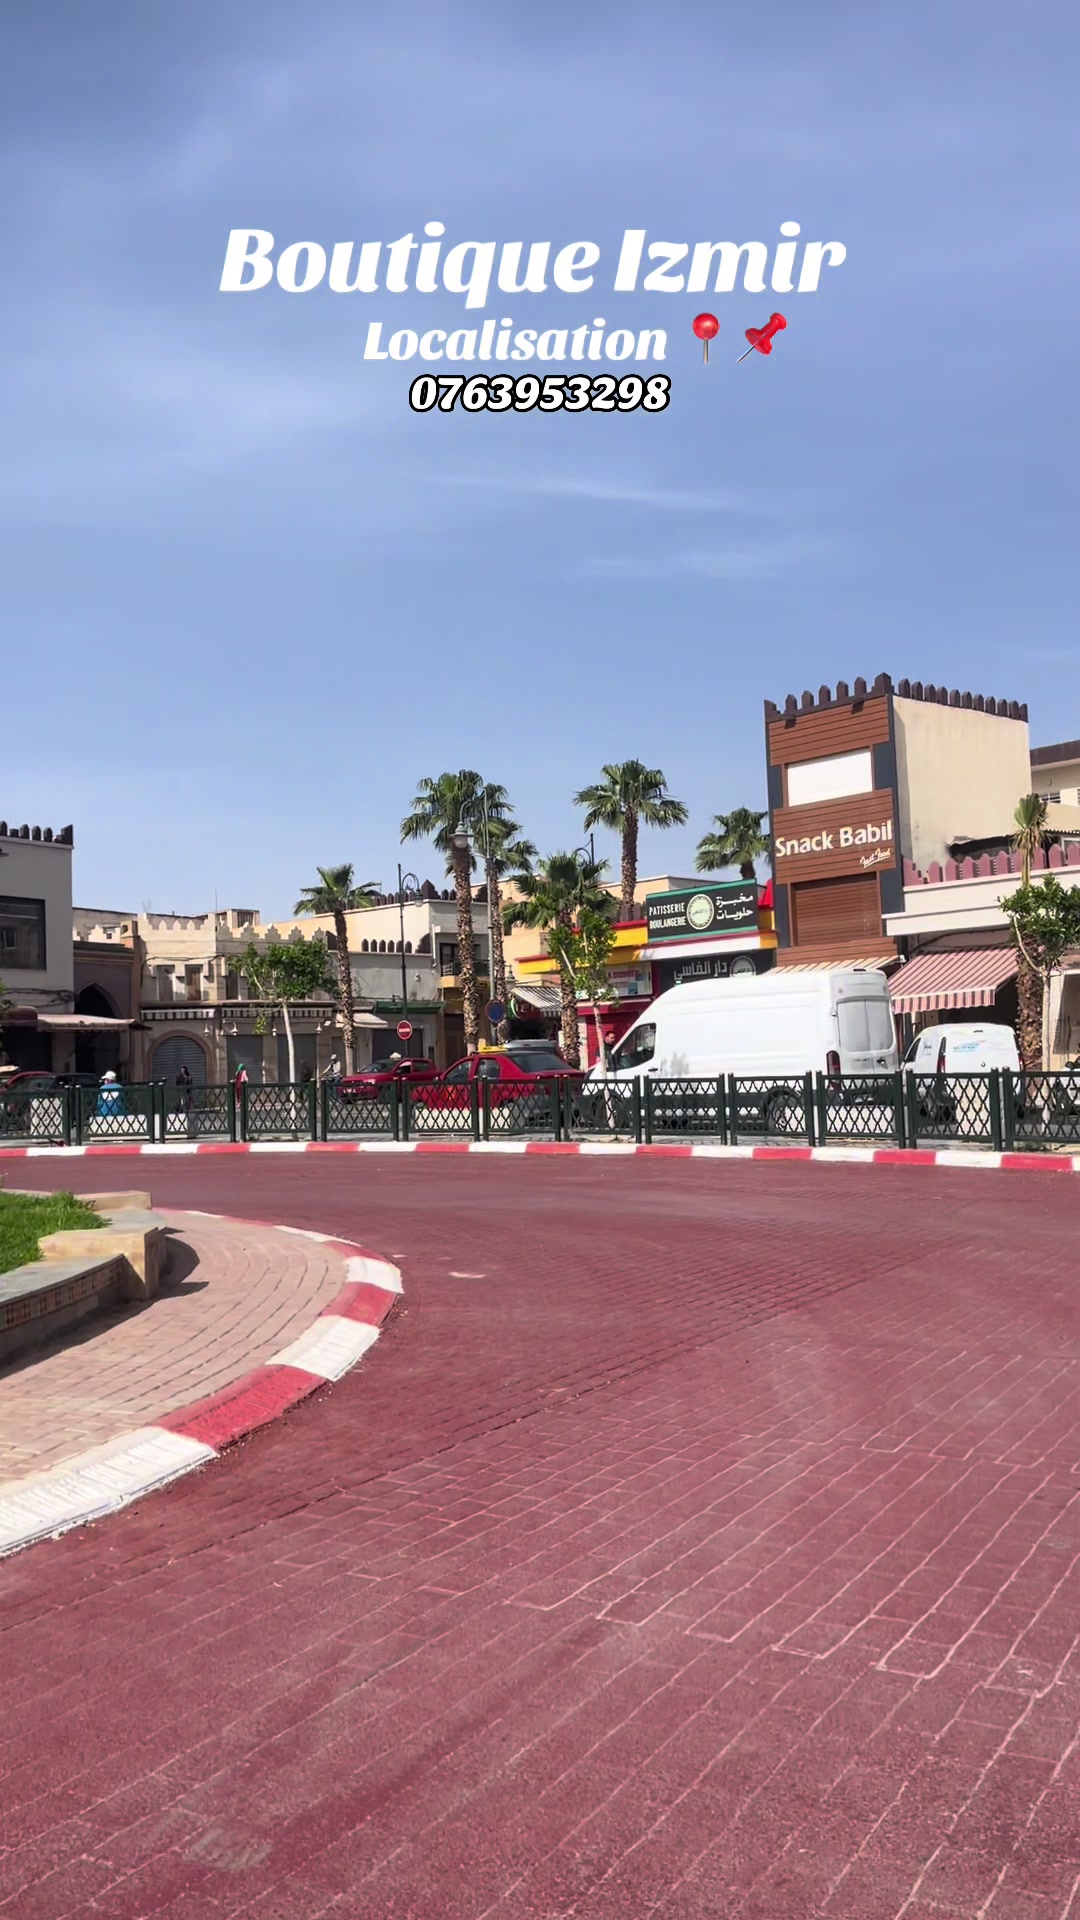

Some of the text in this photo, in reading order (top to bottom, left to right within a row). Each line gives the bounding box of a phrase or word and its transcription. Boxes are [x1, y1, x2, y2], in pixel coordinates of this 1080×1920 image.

[775, 820, 893, 857] Snack Babil
[715, 893, 753, 907] مخبزة
[649, 902, 685, 916] PATISSERIE
[715, 907, 753, 920] حلويات
[649, 915, 687, 930] BOULANGERIE
[673, 959, 728, 984] دار الفاسي
